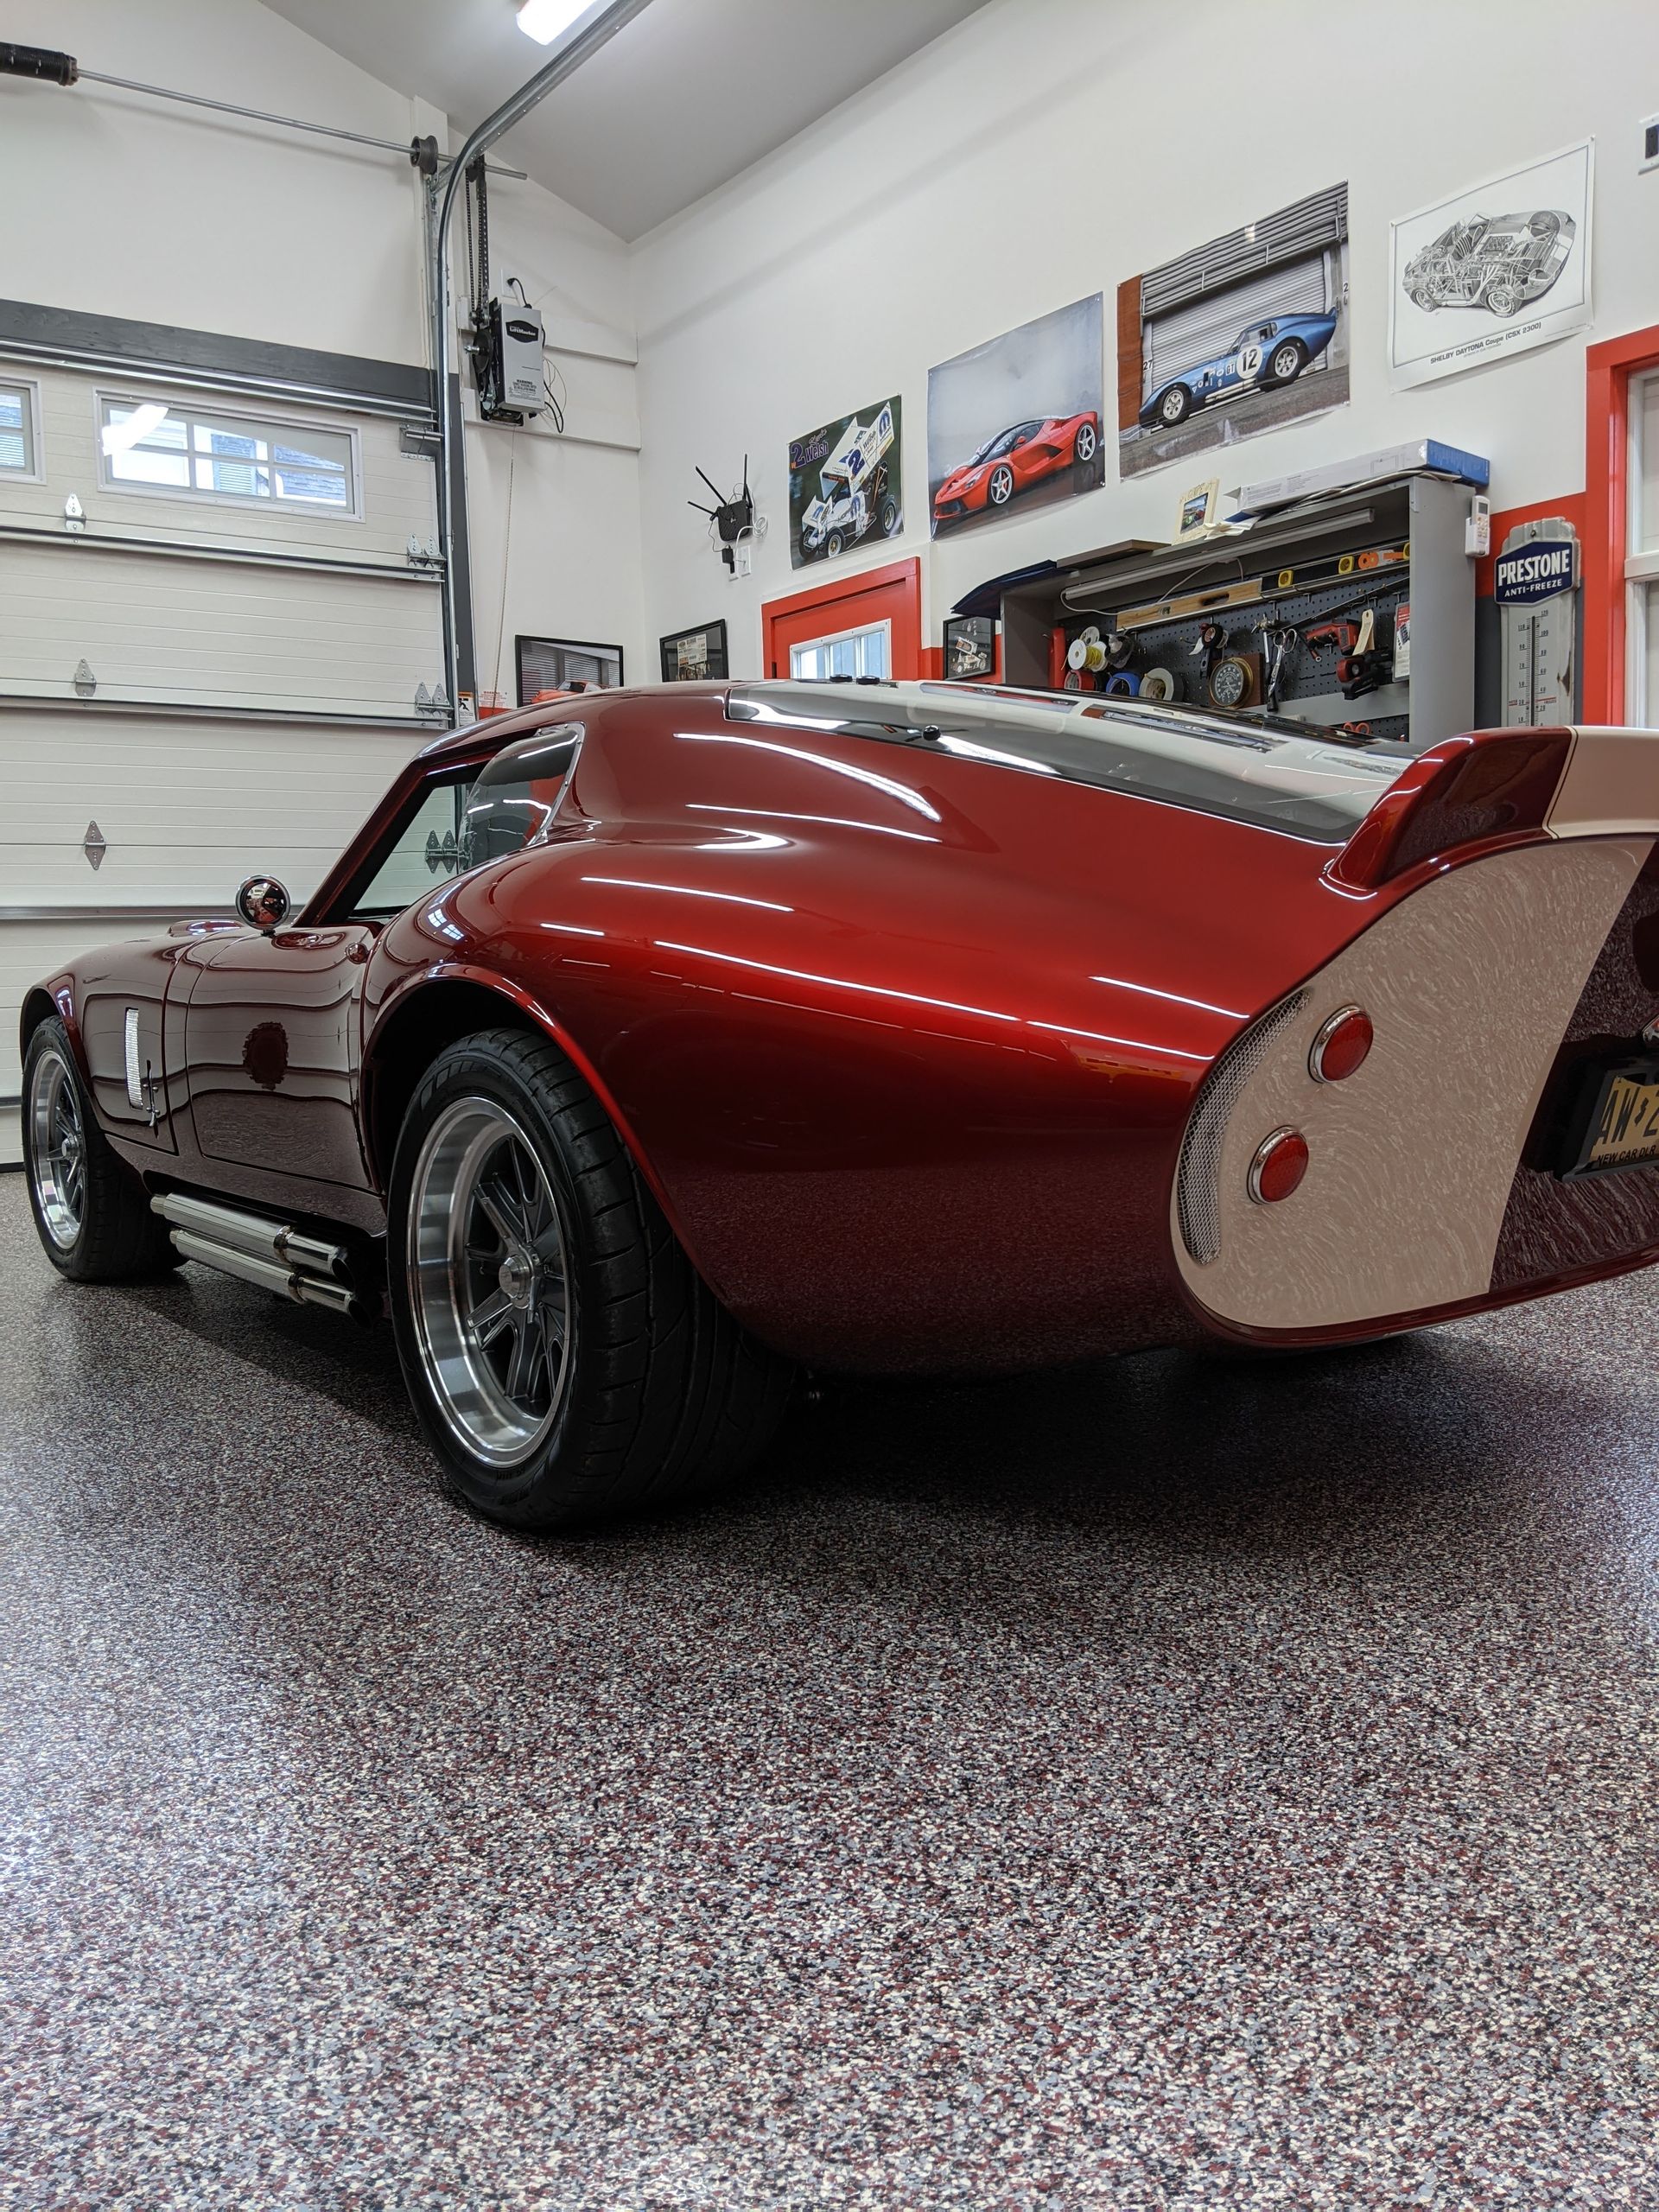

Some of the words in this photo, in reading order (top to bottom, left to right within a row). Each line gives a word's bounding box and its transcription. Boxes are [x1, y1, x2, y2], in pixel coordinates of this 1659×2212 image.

[1430, 351, 1453, 365] SHELBY
[1456, 341, 1484, 357] DAYTONA
[1485, 336, 1503, 350] Coupe
[1522, 321, 1541, 334] 2300)
[1143, 359, 1154, 371] 27
[1226, 364, 1235, 375] GT
[1242, 348, 1257, 372] 12
[791, 442, 807, 469] 2
[805, 440, 829, 463] Welsh
[1498, 549, 1570, 587] PRESTONE
[1504, 578, 1562, 598] ANTI-FREEZE
[1597, 1152, 1618, 1166] NEW
[1619, 1147, 1638, 1160] CAR
[1639, 1144, 1656, 1157] DLR
